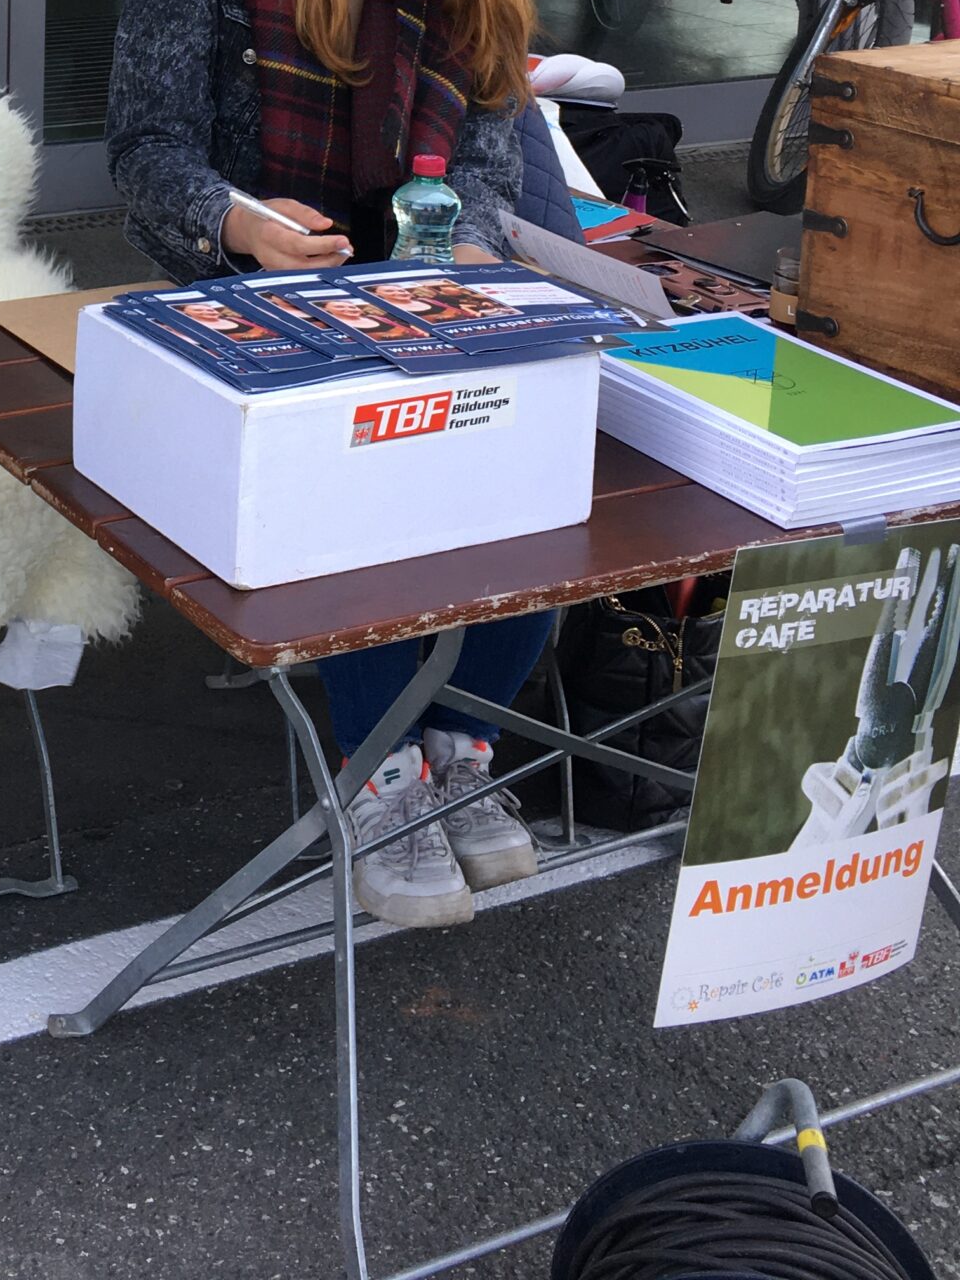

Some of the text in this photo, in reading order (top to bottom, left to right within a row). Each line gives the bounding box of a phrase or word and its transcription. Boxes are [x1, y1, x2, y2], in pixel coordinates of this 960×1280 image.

[628, 333, 758, 358] KITZBÜHEL
[456, 385, 501, 401] Tiroler
[376, 395, 450, 437] TBF
[451, 397, 511, 415] Bildungs
[449, 415, 491, 430] forum
[739, 576, 911, 624] REPARATUR
[688, 839, 925, 917] Anmeldung
[867, 945, 893, 967] TBF
[809, 966, 836, 982] ATM
[699, 978, 749, 1002] Repair
[752, 971, 784, 993] Café
